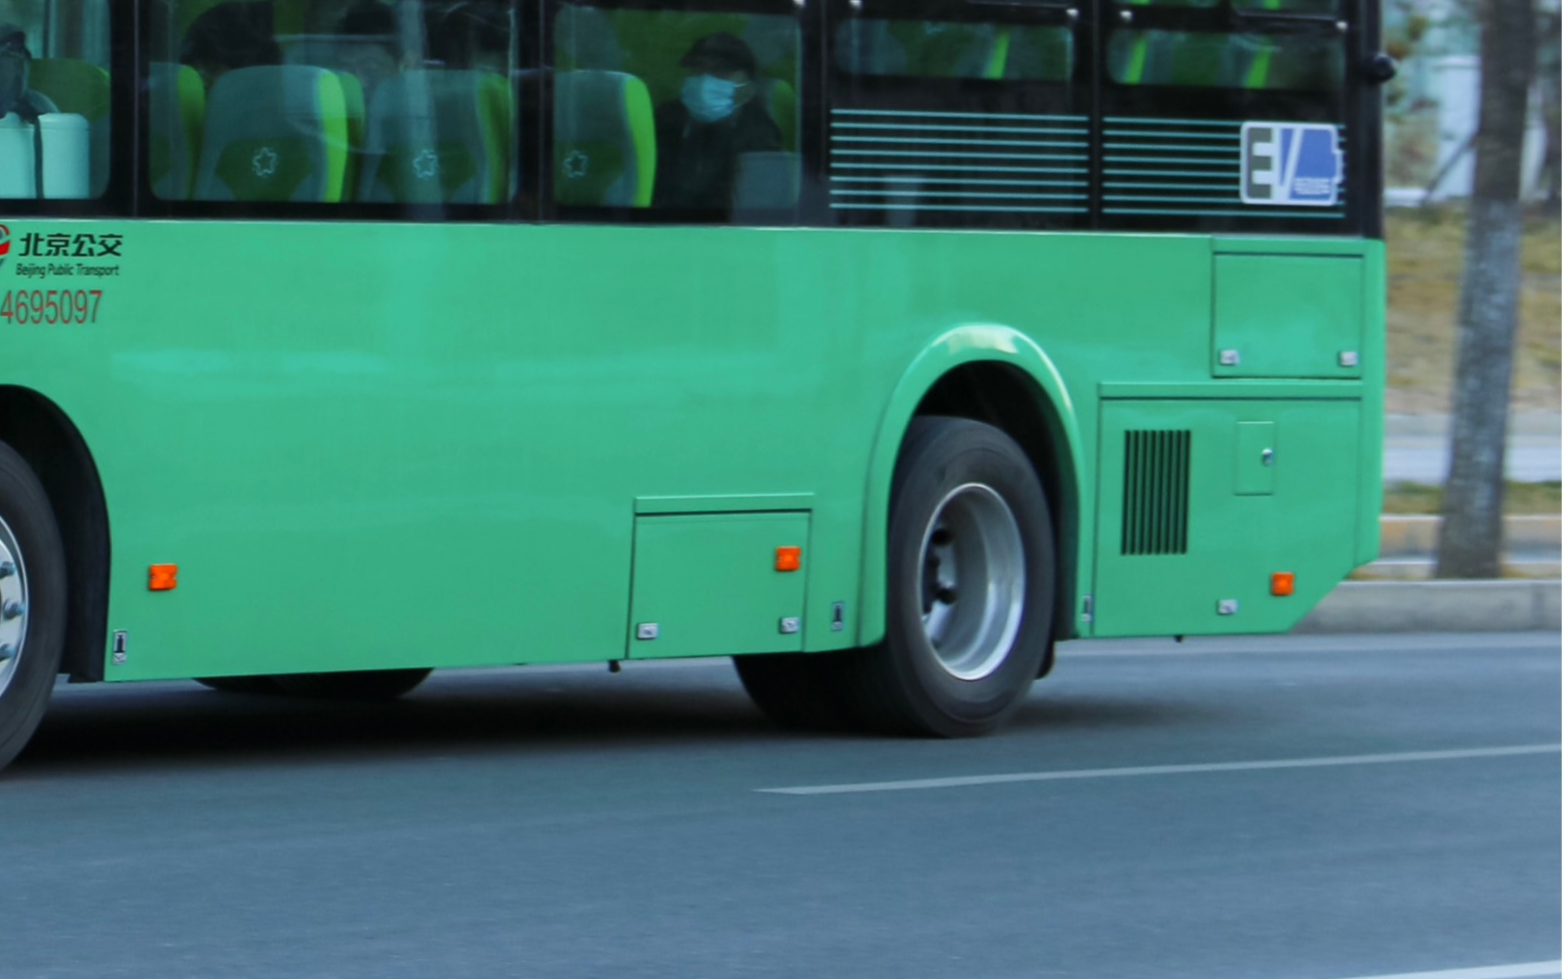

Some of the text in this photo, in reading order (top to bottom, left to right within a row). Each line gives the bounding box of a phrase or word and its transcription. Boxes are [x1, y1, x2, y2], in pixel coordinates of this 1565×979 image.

[18, 232, 123, 257] 北京公交
[16, 263, 120, 279] Beijing Public Transport
[0, 289, 103, 324] 4695097
